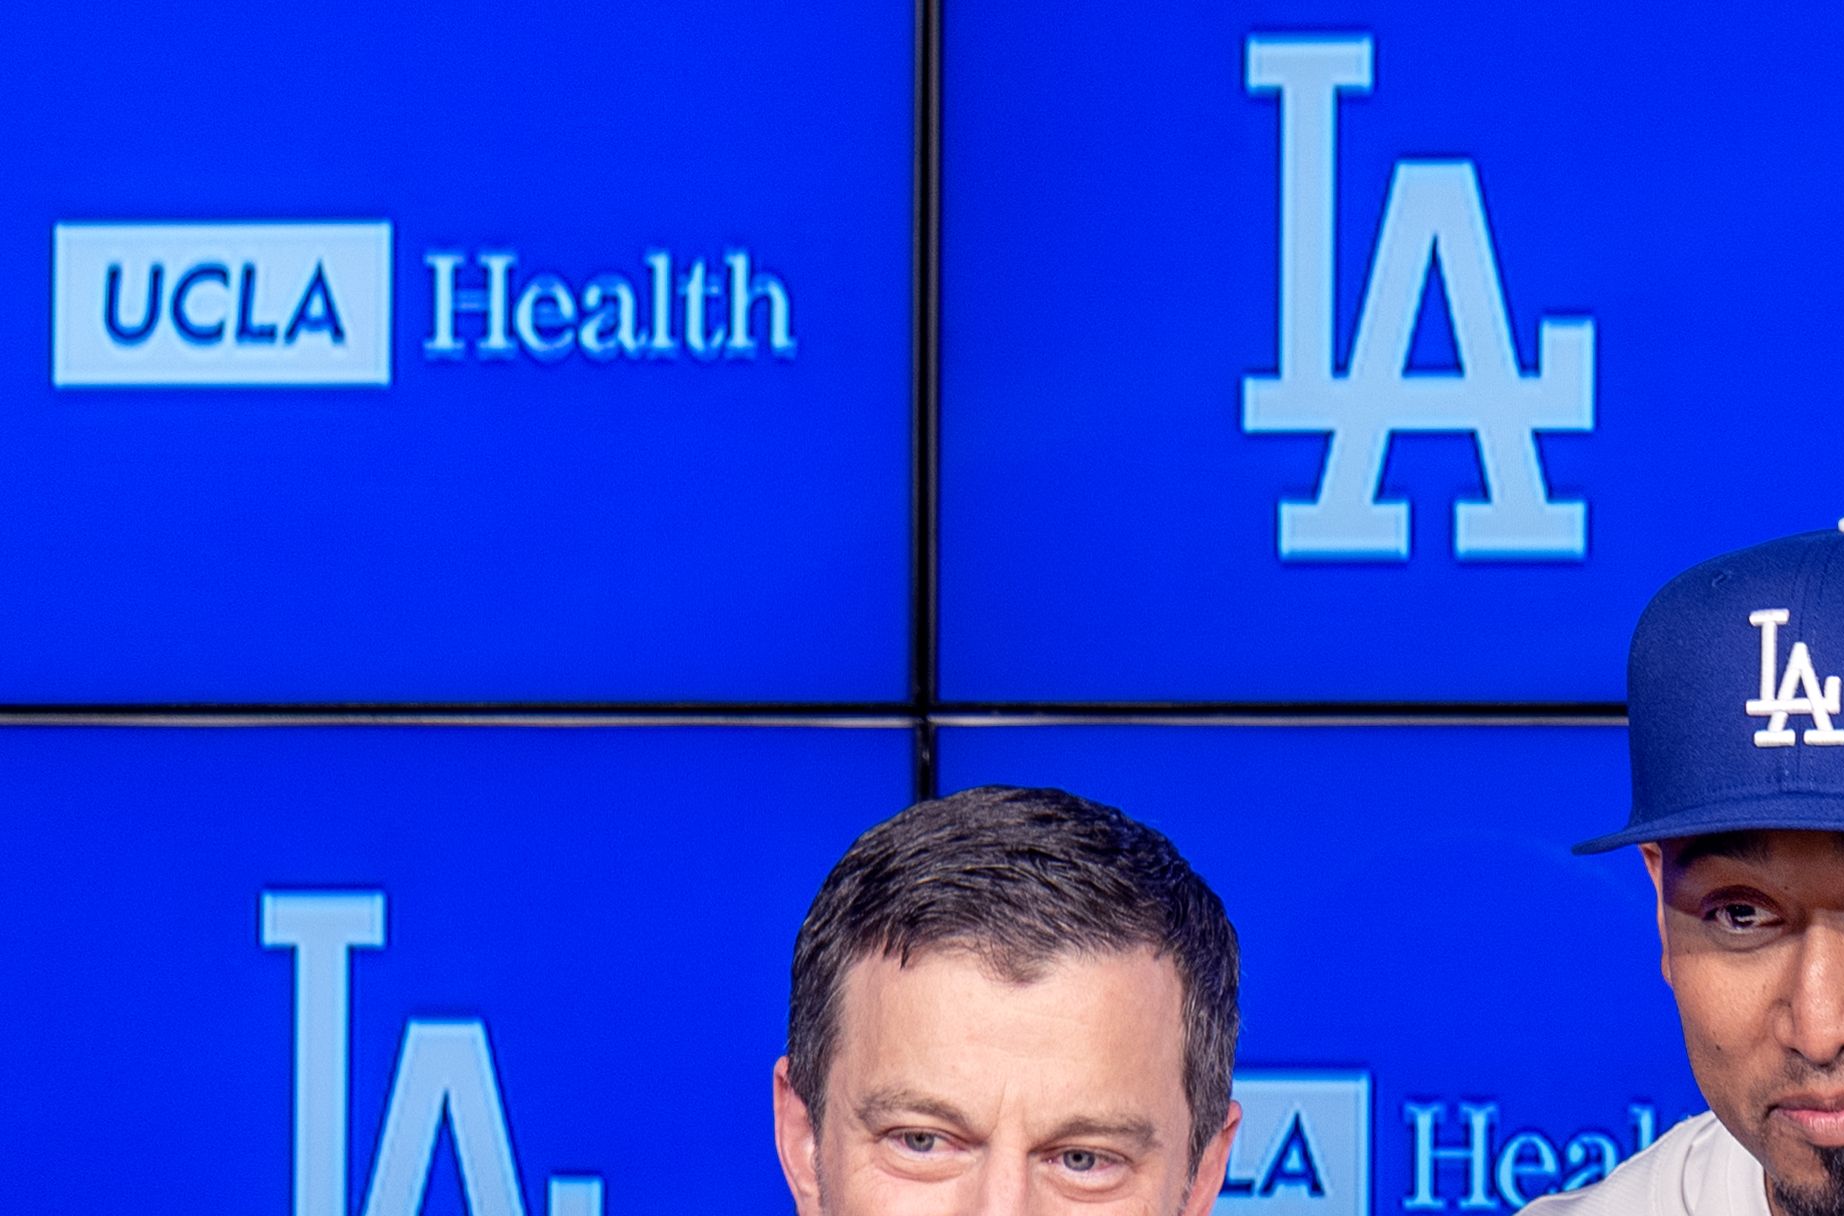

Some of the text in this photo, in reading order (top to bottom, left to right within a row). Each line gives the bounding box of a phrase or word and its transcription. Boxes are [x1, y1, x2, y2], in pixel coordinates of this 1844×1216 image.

[102, 248, 797, 359] UCLA Health
[1242, 34, 1596, 560] LA
